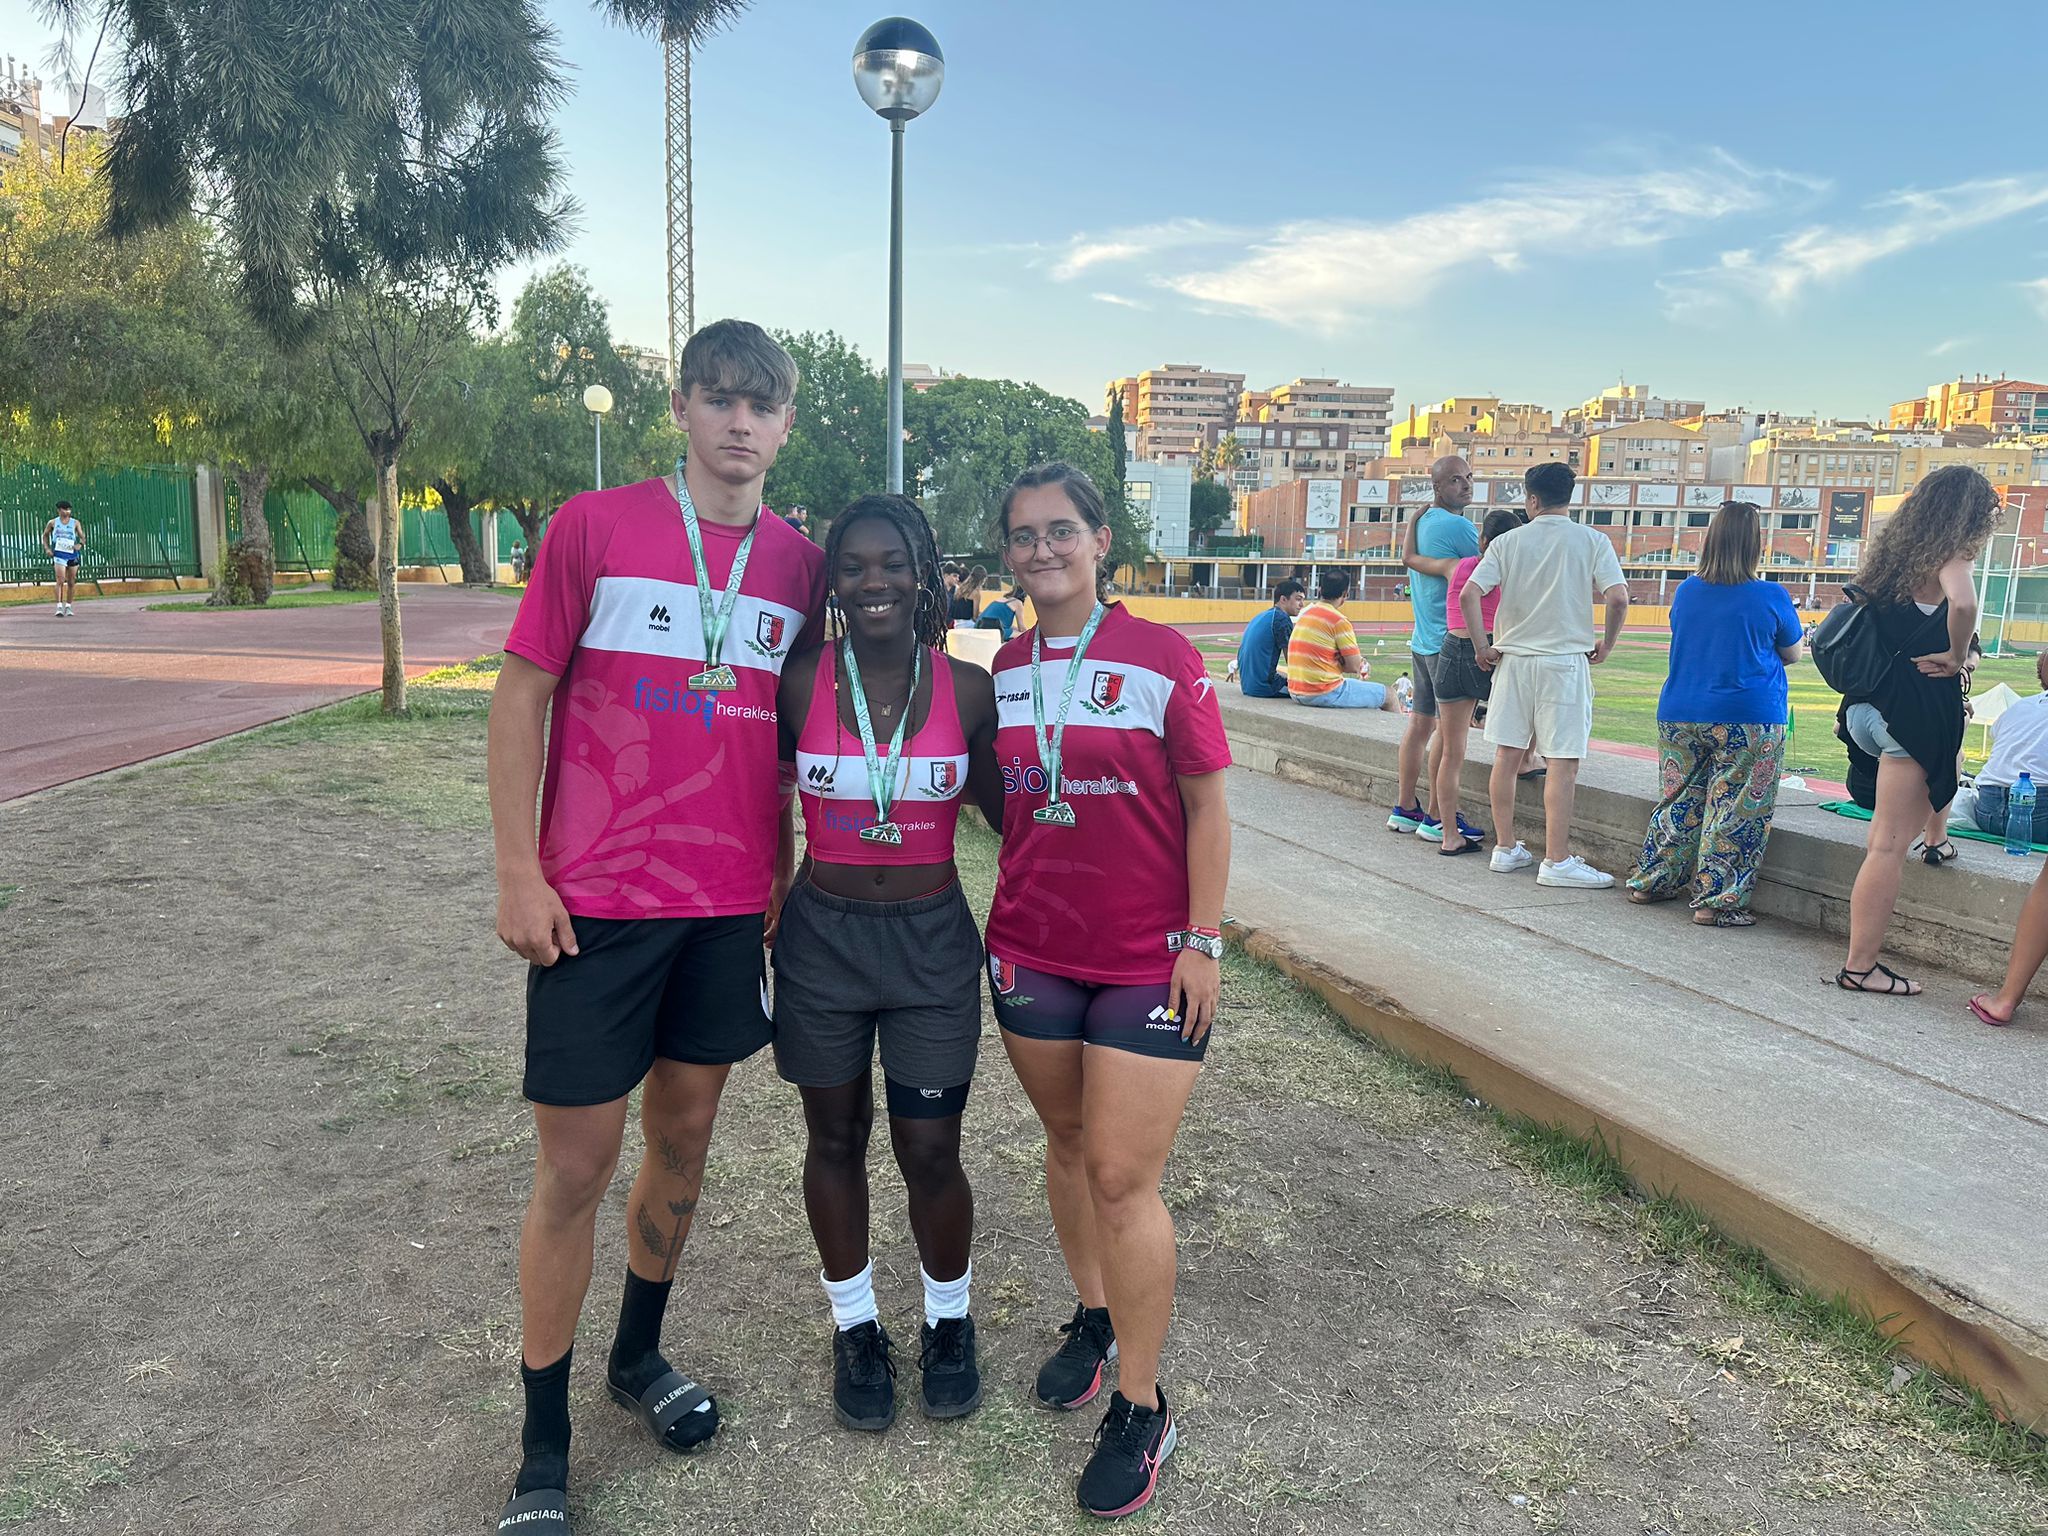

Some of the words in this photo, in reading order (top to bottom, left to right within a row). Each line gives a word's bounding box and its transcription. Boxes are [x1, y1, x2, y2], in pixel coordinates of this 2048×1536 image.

[648, 624, 671, 633] mobel
[634, 676, 702, 715] fisio
[716, 701, 778, 723] herakles
[1002, 756, 1049, 794] sio
[1060, 774, 1139, 796] herakles
[896, 821, 936, 832] erakles
[1145, 1022, 1180, 1032] mobel
[653, 1381, 698, 1415] BALENCIAGA
[498, 1509, 565, 1530] BALENCIAGA
